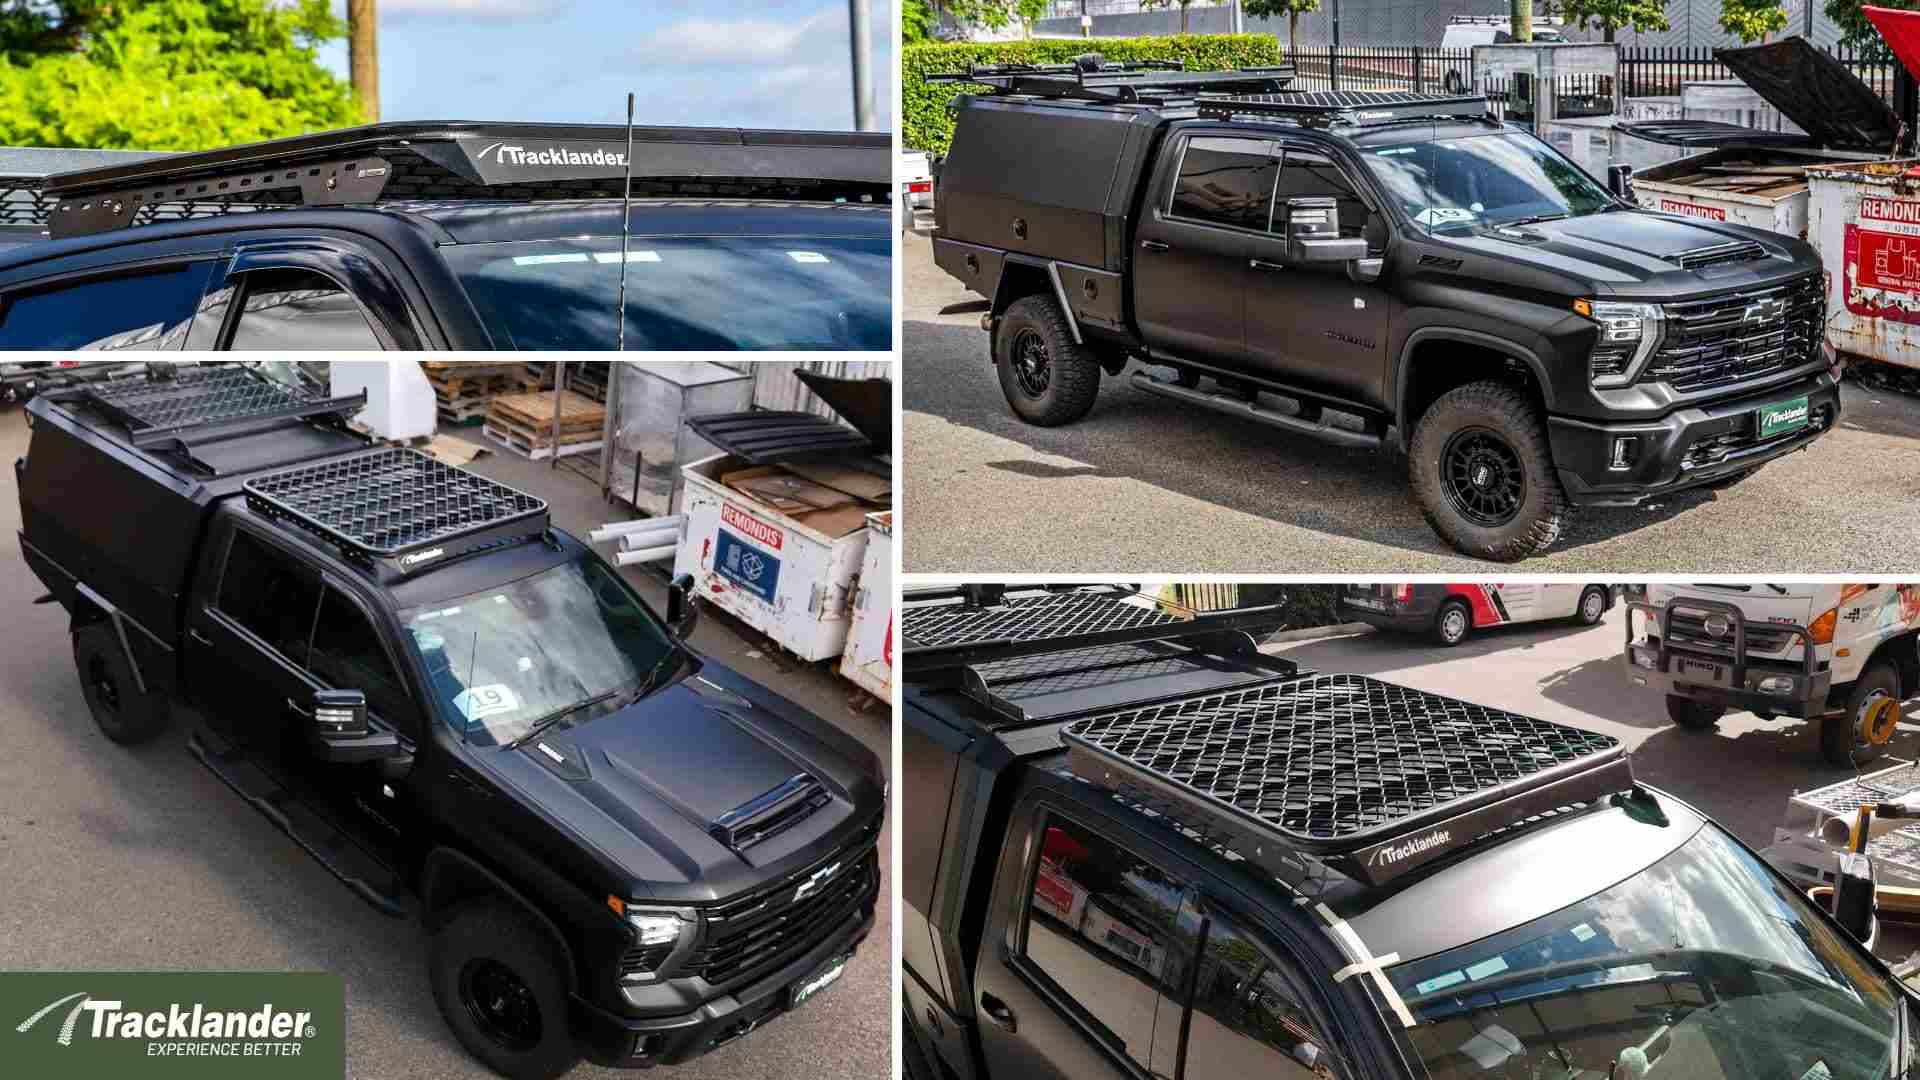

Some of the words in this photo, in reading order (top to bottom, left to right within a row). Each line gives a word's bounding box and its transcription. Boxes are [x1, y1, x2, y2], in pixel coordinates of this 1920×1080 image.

[503, 146, 627, 166] Tracklander
[723, 505, 780, 546] REMONDIS
[1380, 830, 1451, 865] Tracklander
